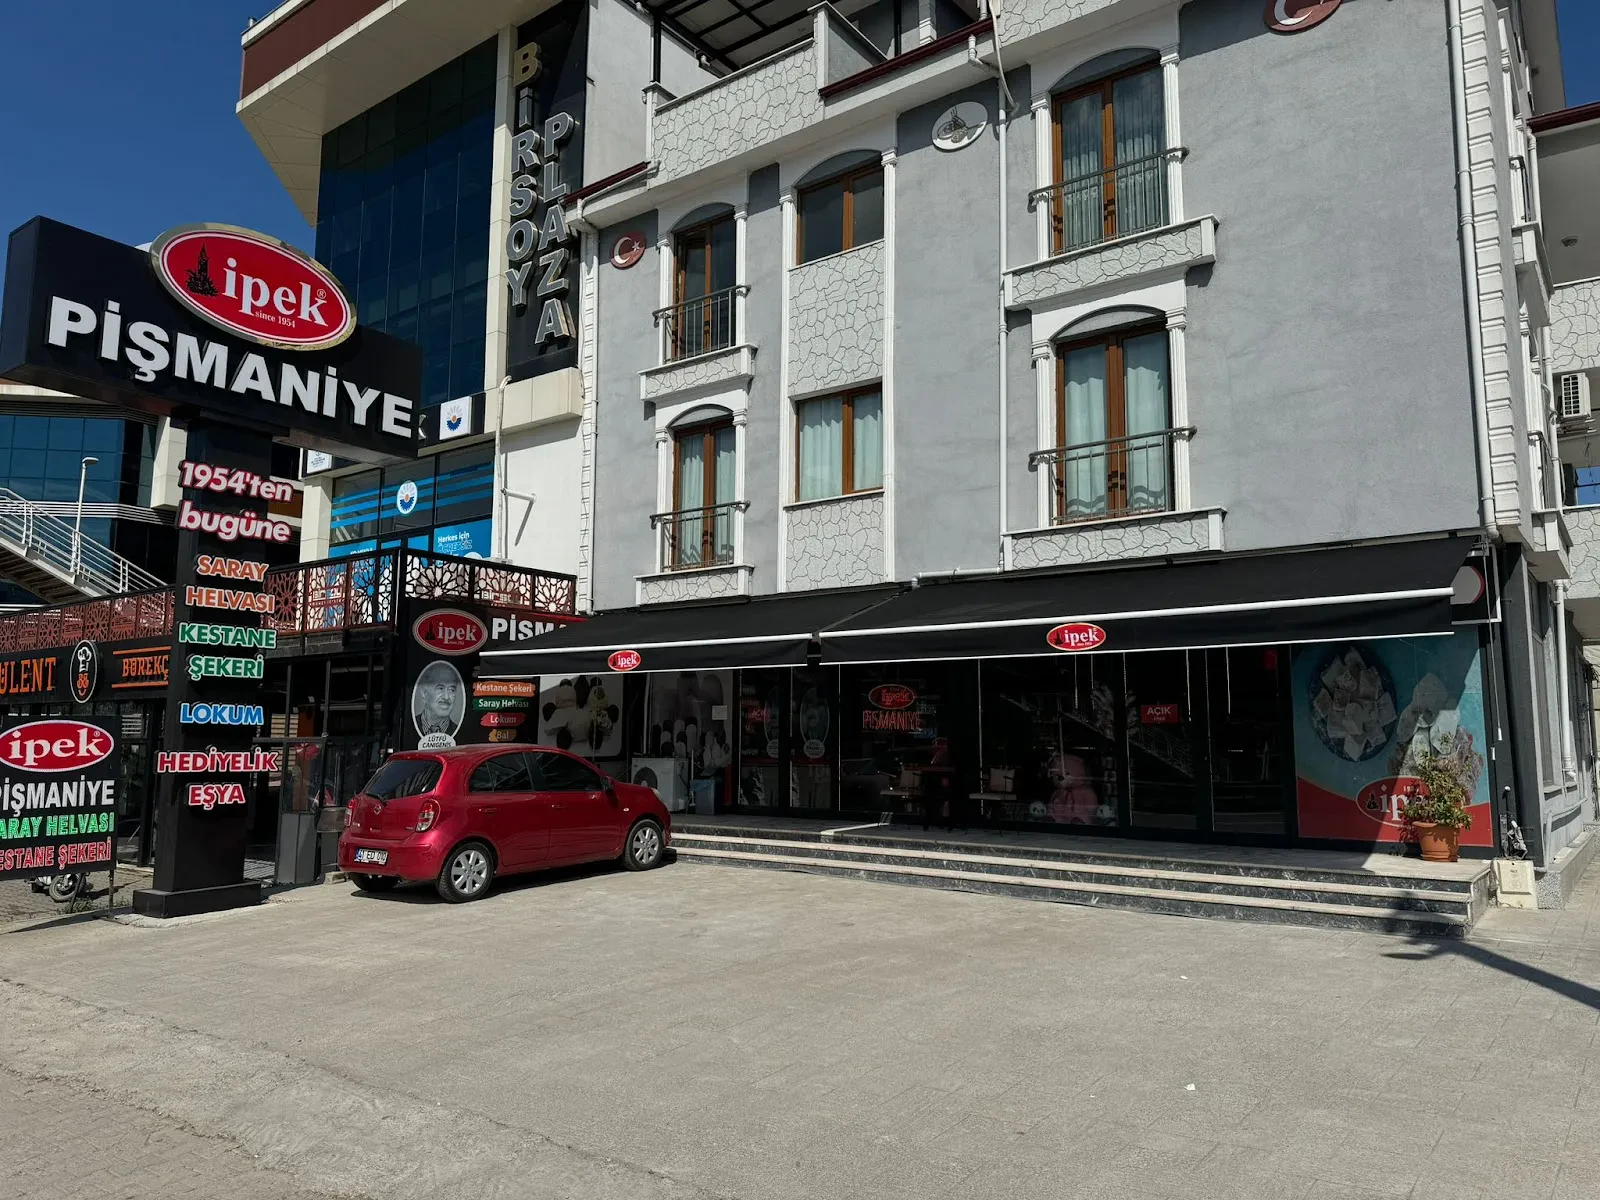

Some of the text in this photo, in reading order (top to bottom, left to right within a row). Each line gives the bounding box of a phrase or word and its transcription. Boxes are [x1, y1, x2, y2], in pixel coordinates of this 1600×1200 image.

[503, 41, 542, 307] BİRSOY
[534, 111, 576, 345] PLAZA
[222, 257, 328, 327] ipek
[255, 310, 296, 328] since 1954
[48, 295, 413, 439] PİŞMANİYE
[181, 461, 293, 502] 1954'ten
[179, 500, 291, 542] bugüne
[197, 554, 269, 582] SARAY
[186, 585, 275, 613] HELVASI
[179, 622, 277, 649] KESTANE
[437, 621, 477, 645] ipek
[1064, 628, 1100, 647] ipek
[189, 654, 265, 681] ŞEKERİ
[617, 653, 637, 668] ipek
[476, 682, 533, 694] Kestane Şekeri
[180, 703, 264, 726] LOKUM
[478, 699, 529, 709] Saray Helvası
[1146, 706, 1172, 716] AÇIK
[490, 714, 517, 724] Lokum
[8, 728, 104, 766] ipek
[496, 730, 510, 740] Bal
[157, 746, 279, 773] HEDİYELİK
[0, 775, 115, 817] İŞMANİYE
[188, 783, 246, 810] EŞYA
[46, 812, 115, 836] HELVASI
[58, 836, 112, 870] ŞEKERİ
